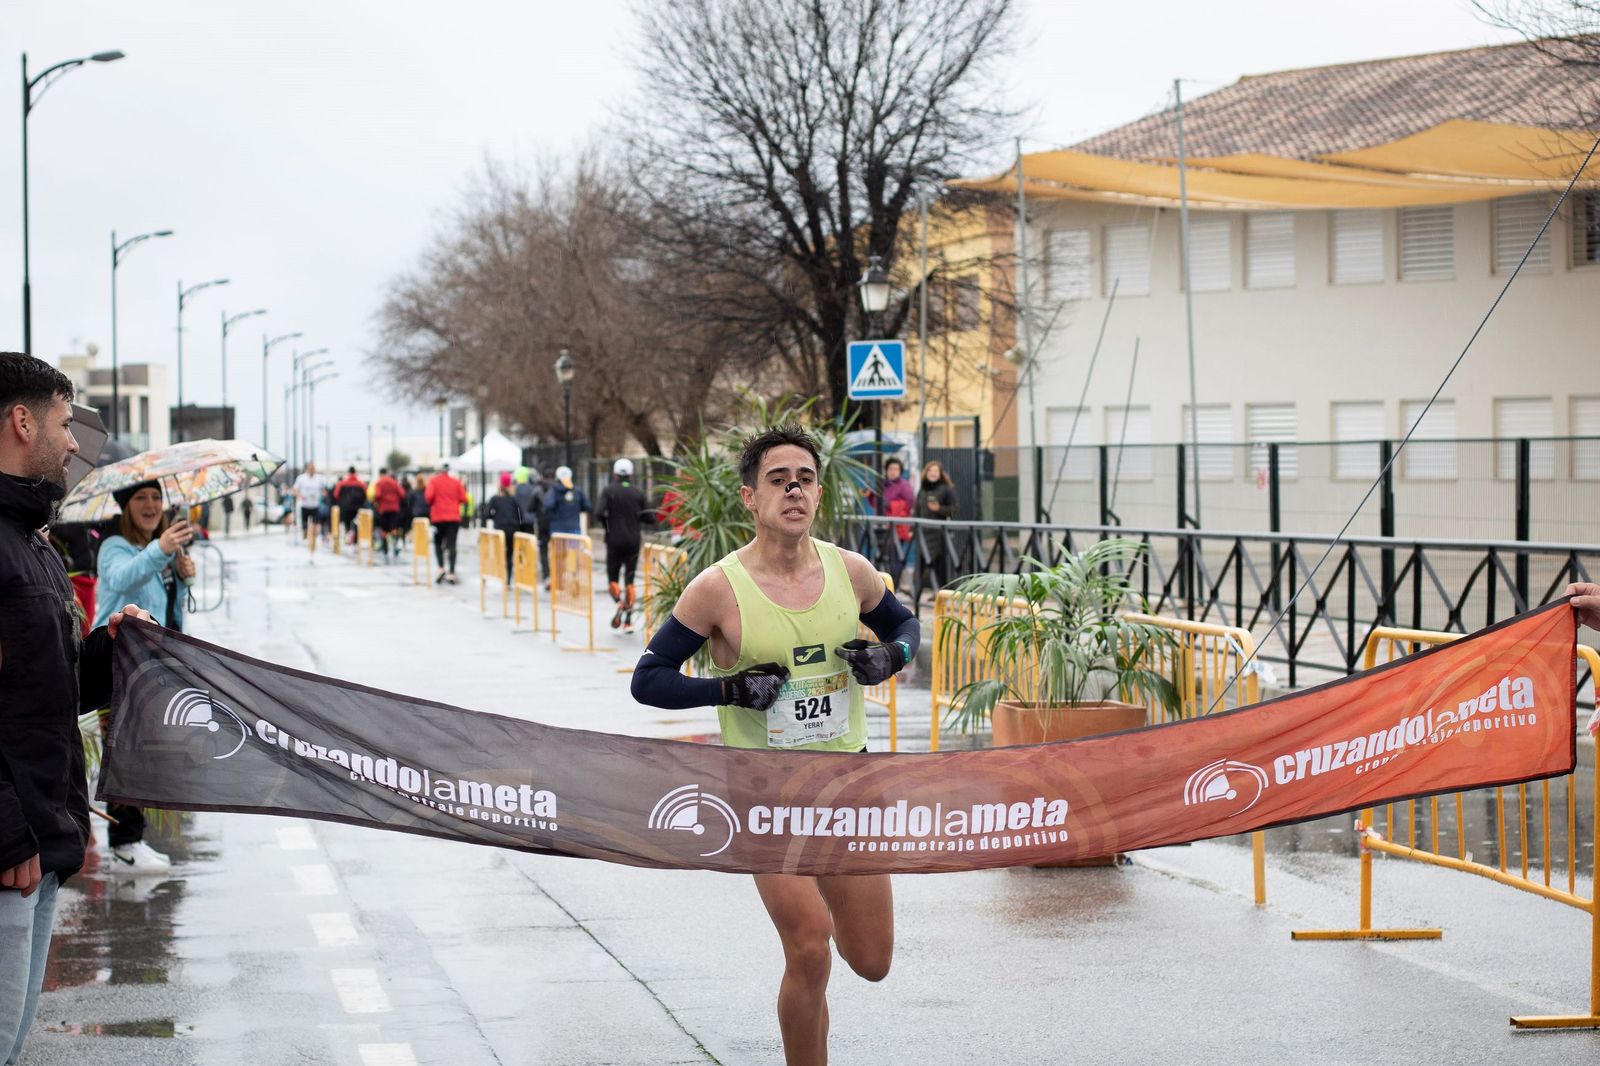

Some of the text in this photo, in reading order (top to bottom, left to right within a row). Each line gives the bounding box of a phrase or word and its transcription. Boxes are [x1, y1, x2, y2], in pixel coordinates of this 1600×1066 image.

[795, 696, 832, 722] 524
[804, 721, 824, 729] YERAY
[470, 808, 558, 831] deportivo
[748, 797, 1069, 838] cruzandolameta
[847, 830, 1069, 853] cronometraje deportivo
